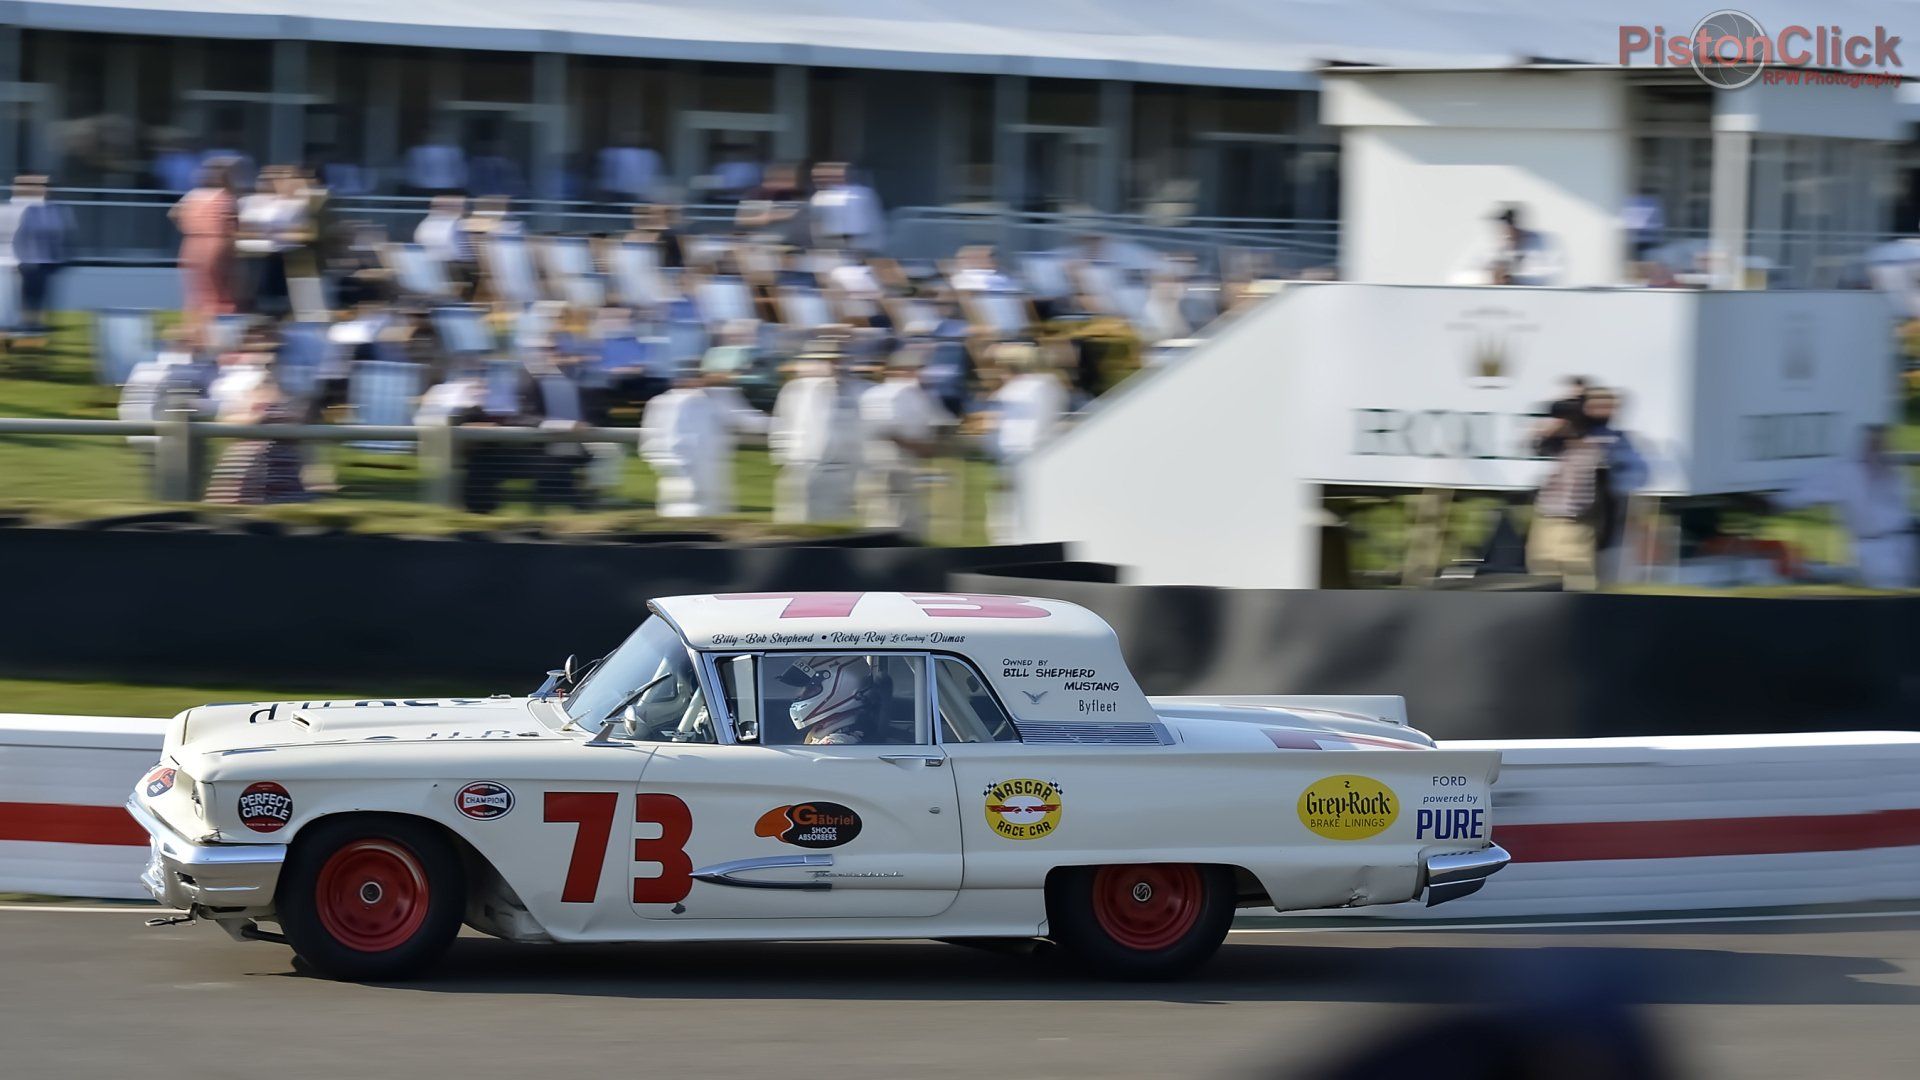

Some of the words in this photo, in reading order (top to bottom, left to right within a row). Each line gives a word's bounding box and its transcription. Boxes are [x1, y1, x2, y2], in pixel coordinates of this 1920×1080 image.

[769, 632, 815, 646] Shepherd
[830, 631, 886, 645] Ricky-Roy
[930, 631, 966, 644] Dumas
[1002, 658, 1033, 667] OWNED
[1038, 659, 1049, 667] BY
[1003, 668, 1030, 678] BILL
[1036, 668, 1096, 678] SHEPHERD
[1064, 681, 1120, 692] MUSTANG
[1078, 699, 1117, 715] Byfleet
[1432, 776, 1467, 787] FORD
[993, 781, 1053, 802] NASCAR
[240, 793, 292, 809] PERFECT
[1306, 791, 1392, 818] Grey-Rock
[1422, 794, 1465, 805] powered
[1467, 794, 1478, 805] by
[242, 805, 290, 821] CIRCLE
[811, 826, 837, 834] SHOCK
[997, 821, 1025, 837] RACE
[1029, 821, 1052, 836] CAR
[1310, 819, 1340, 828] BRAKE
[1345, 819, 1385, 828] LININGS
[1416, 808, 1484, 840] PURE
[798, 833, 837, 841] ABSORBERS
[543, 792, 694, 904] 73
